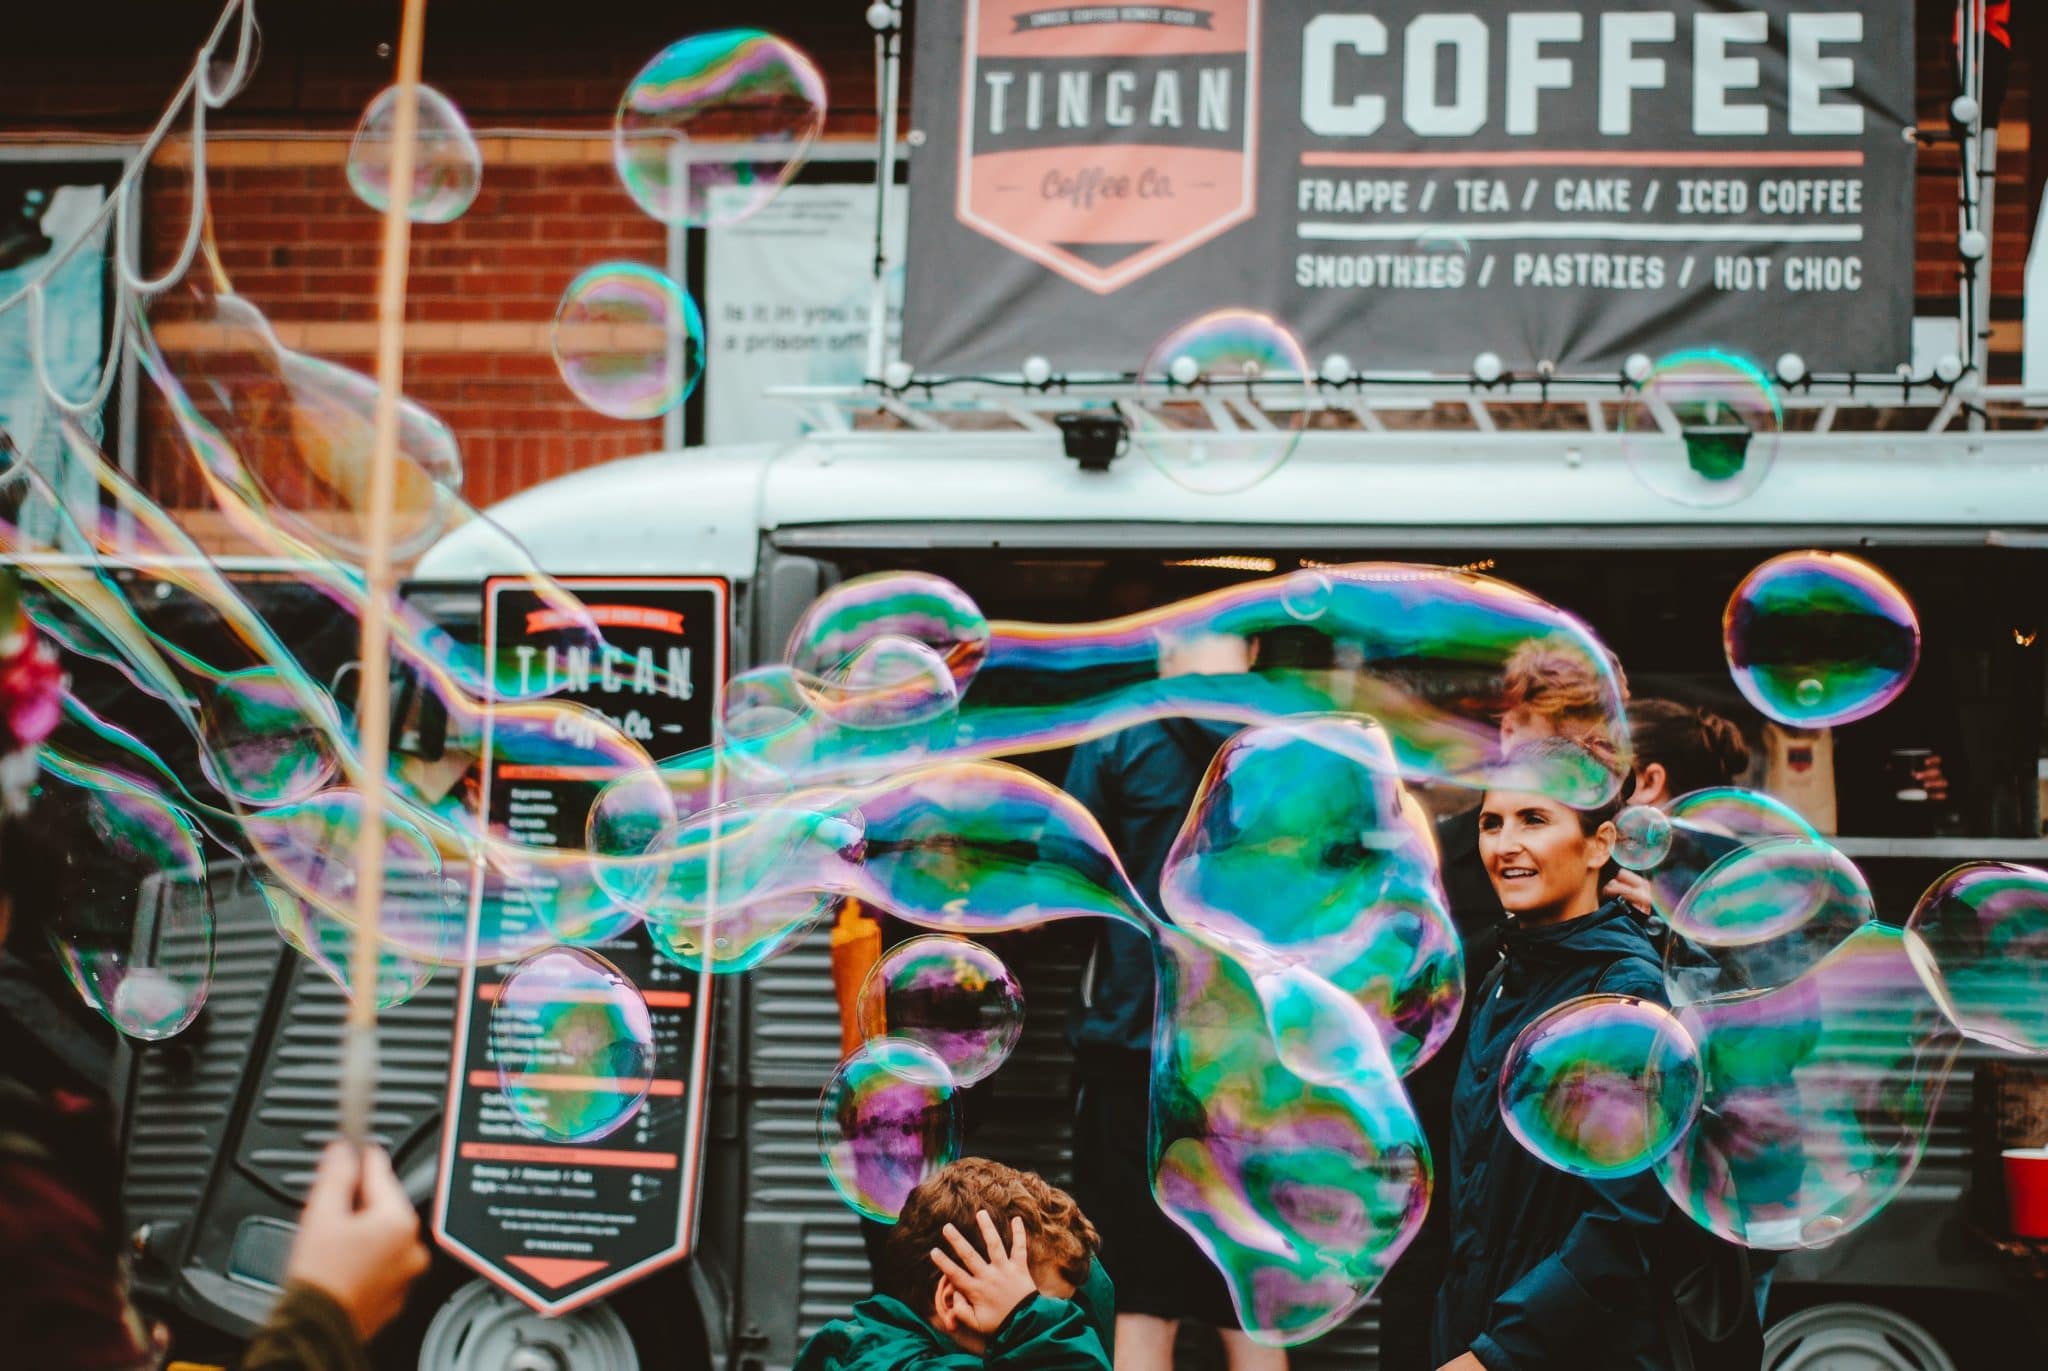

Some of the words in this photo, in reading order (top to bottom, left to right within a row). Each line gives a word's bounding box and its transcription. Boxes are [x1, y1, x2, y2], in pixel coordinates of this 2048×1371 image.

[1302, 12, 1864, 135] COFFEE
[985, 68, 1231, 133] TINCAN
[1041, 166, 1130, 209] Coffee
[1299, 178, 1409, 213] FRAPPE
[1454, 179, 1511, 212] TEA
[1554, 178, 1632, 212] CAKE
[1677, 179, 1748, 214] ICED
[1758, 179, 1863, 214] COFFEE
[1295, 253, 1466, 288] SMOOTHIES
[1513, 253, 1665, 289] PASTRIES
[1714, 256, 1772, 291] HOT
[1784, 256, 1863, 291] CHOC
[803, 307, 846, 327] you
[515, 645, 692, 700] TINCAN
